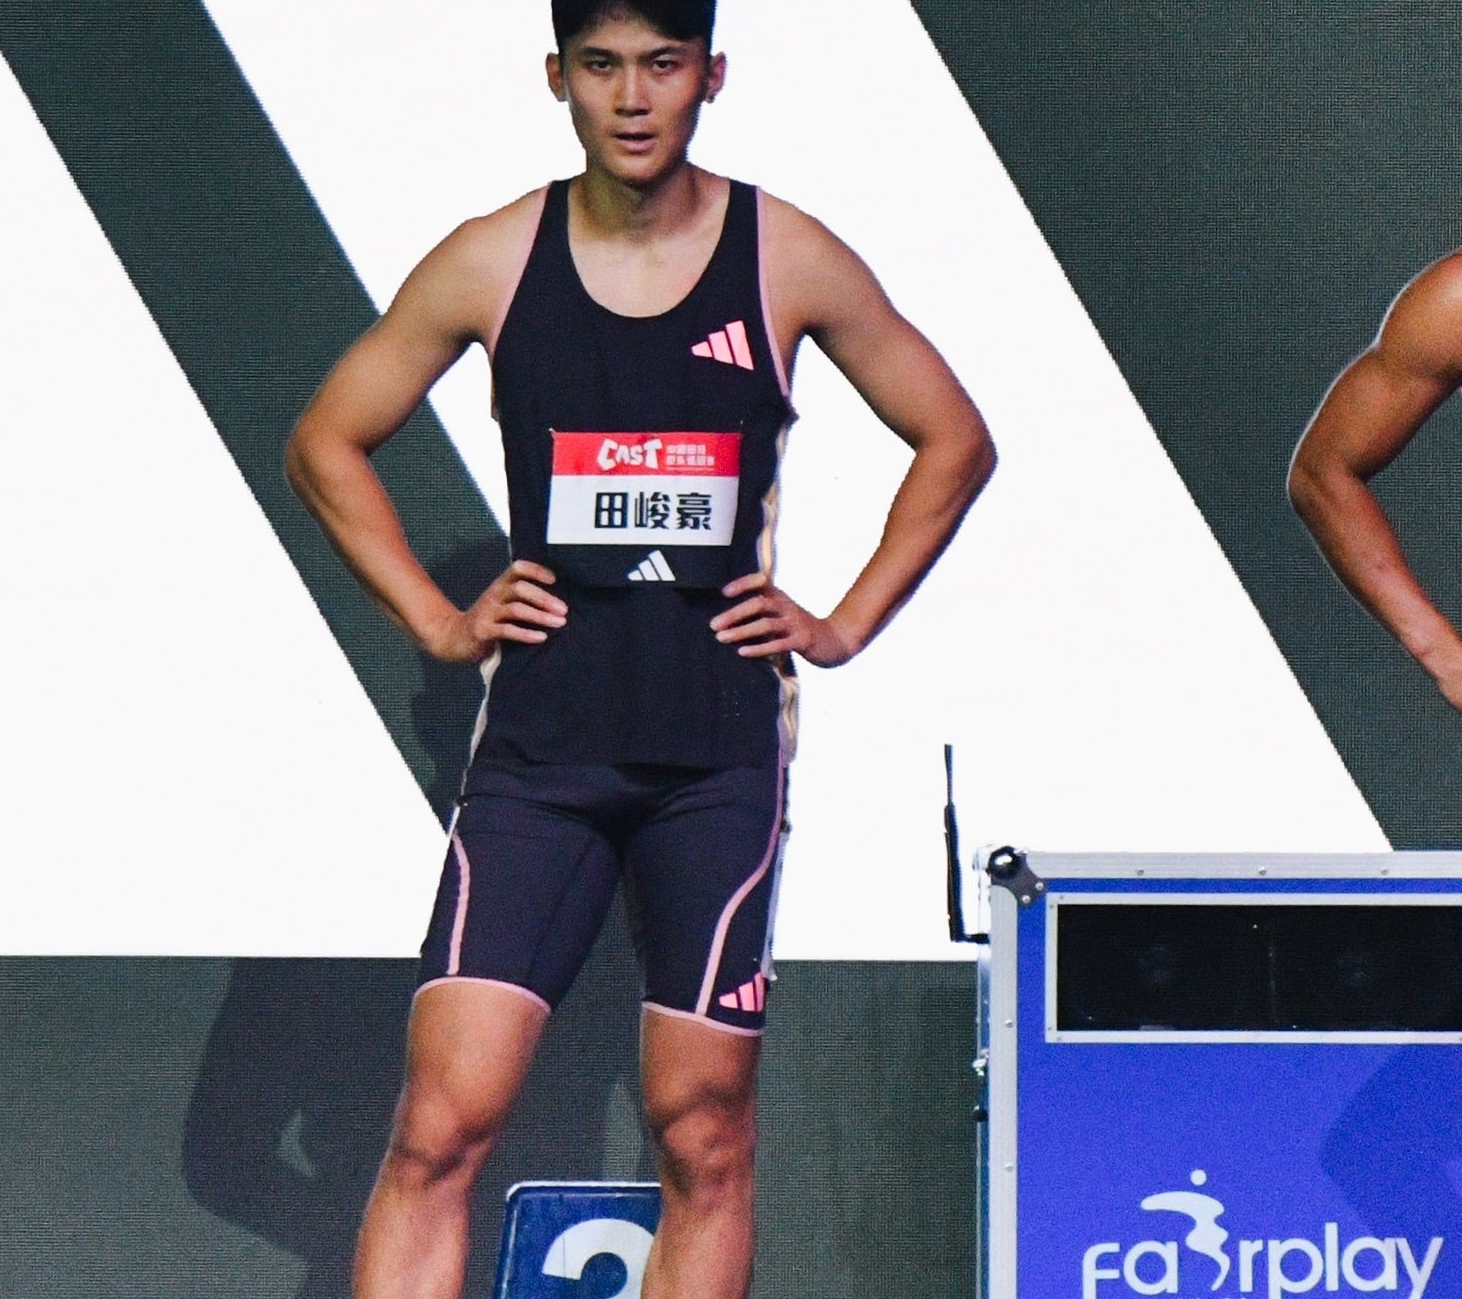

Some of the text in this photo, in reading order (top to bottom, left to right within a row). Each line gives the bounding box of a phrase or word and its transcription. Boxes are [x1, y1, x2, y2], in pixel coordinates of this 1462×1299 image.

[597, 438, 662, 471] CAST
[594, 491, 712, 530] 田峻豪
